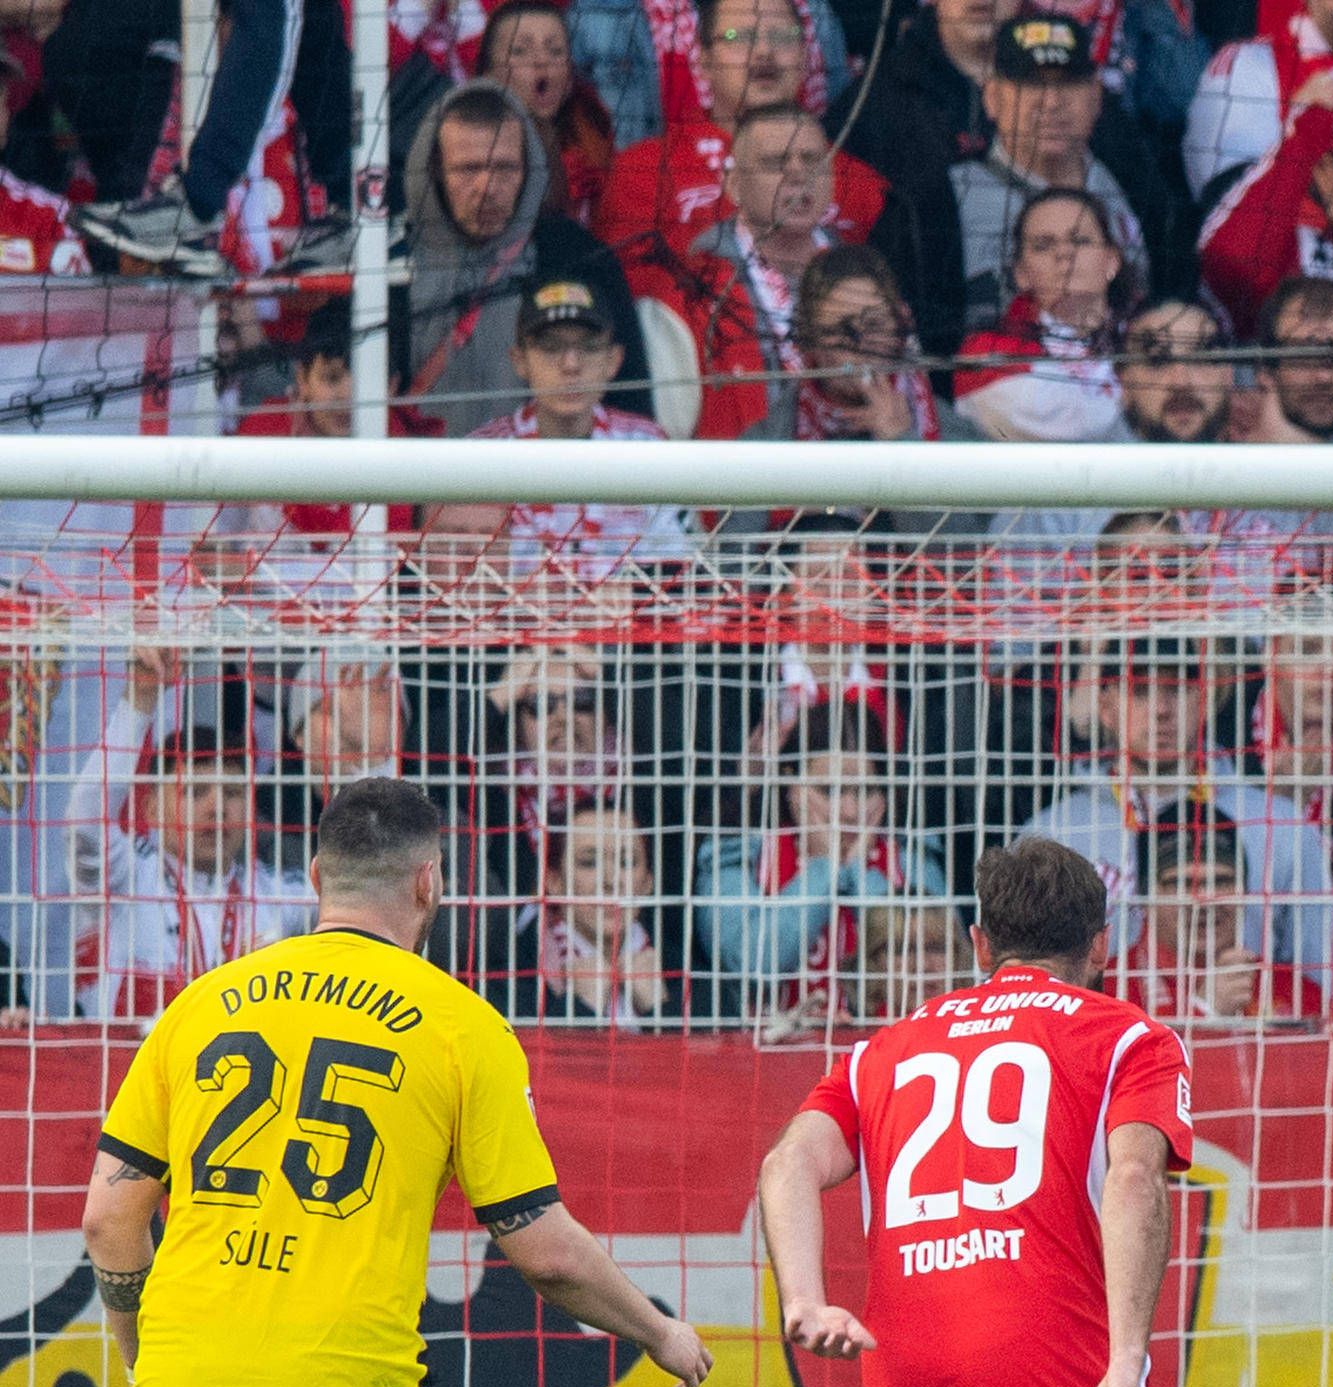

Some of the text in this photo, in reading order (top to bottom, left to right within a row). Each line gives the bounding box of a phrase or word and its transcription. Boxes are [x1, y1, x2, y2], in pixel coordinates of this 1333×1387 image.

[220, 970, 423, 1034] DORTMUND
[936, 997, 979, 1017] FC
[981, 991, 1083, 1016] UNION
[947, 1015, 1014, 1038] BERLIN
[191, 1031, 406, 1219] 25
[885, 1041, 1052, 1229] 29
[898, 1228, 1025, 1276] TOUSART
